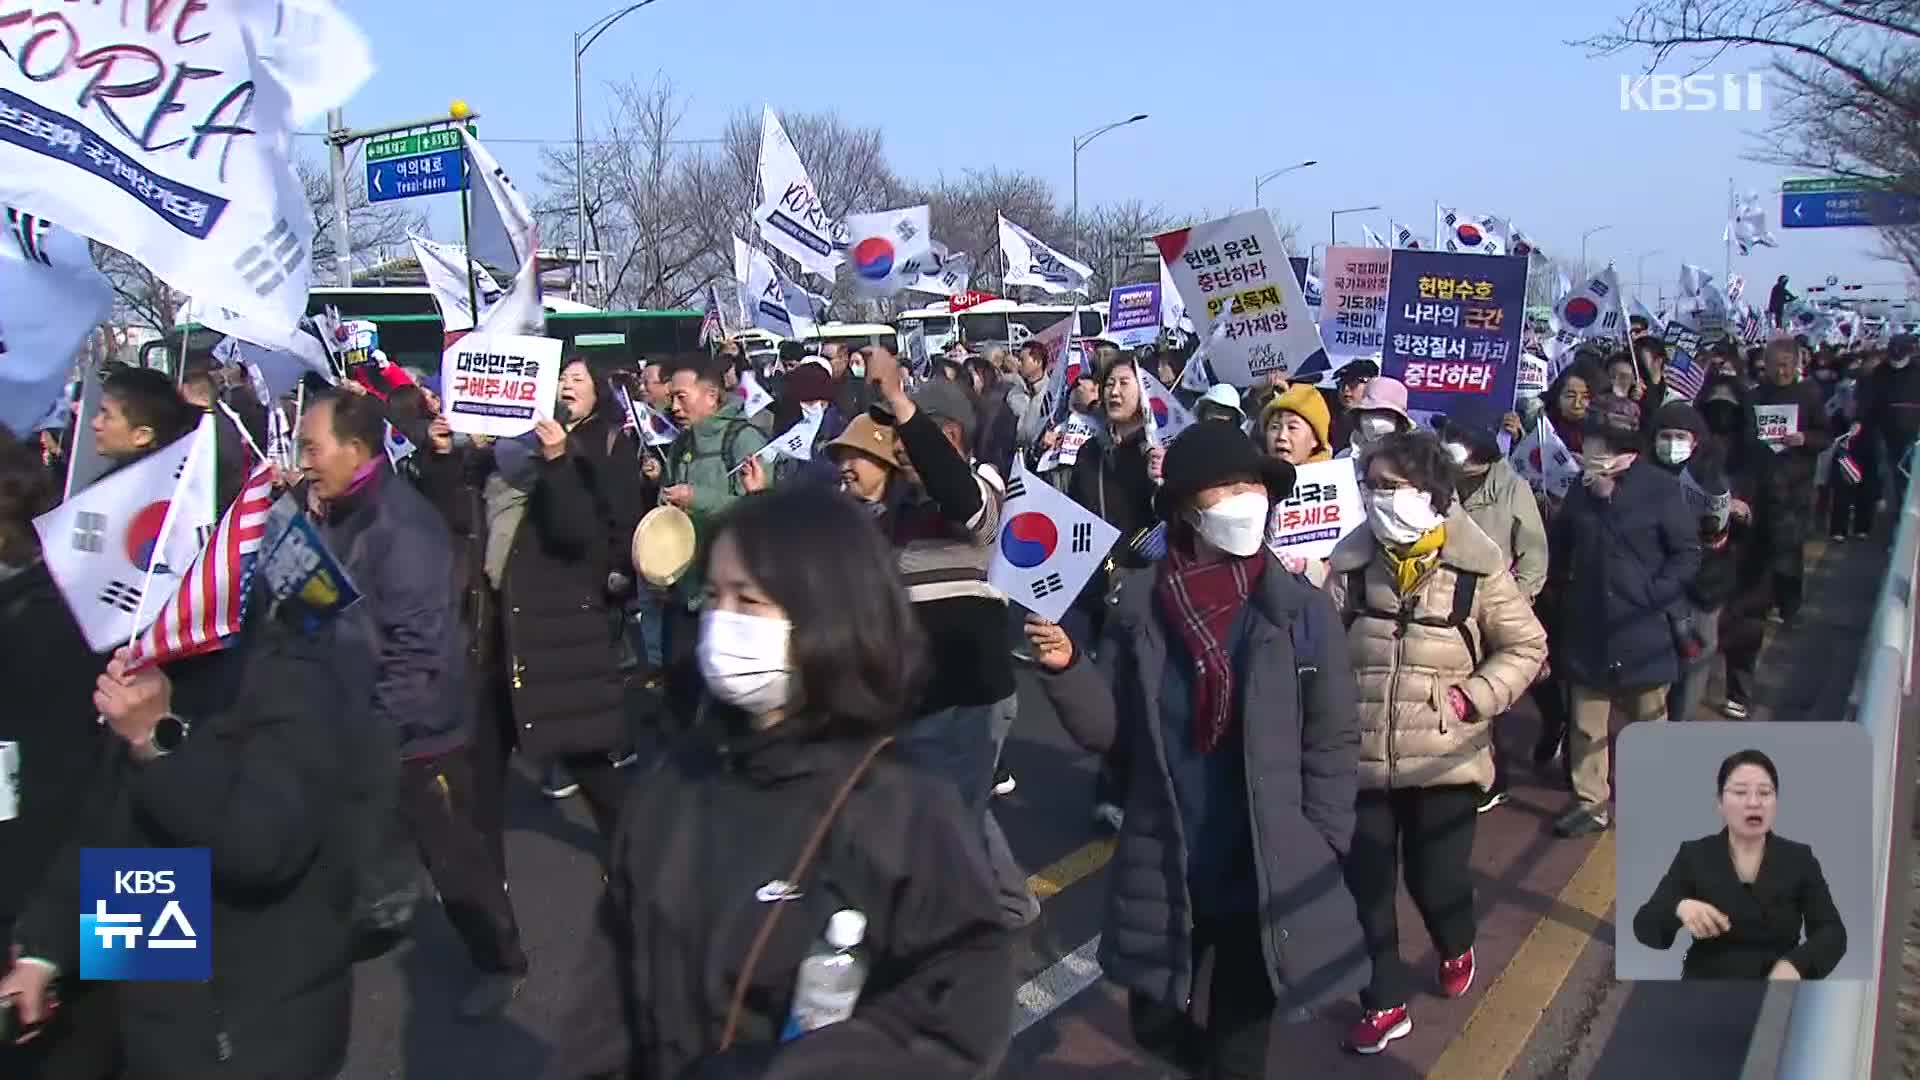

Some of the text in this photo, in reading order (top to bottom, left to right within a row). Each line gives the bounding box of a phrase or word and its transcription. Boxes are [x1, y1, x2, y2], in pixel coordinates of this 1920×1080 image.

[396, 156, 443, 178] 여의대로
[1183, 234, 1262, 271] 헌법 유린
[1198, 259, 1268, 293] 중단하라
[1418, 275, 1494, 301] 헌법수호
[1335, 311, 1377, 329] 국민이
[1404, 303, 1504, 331] 나라의 근간
[1392, 333, 1510, 365] 헌정질서 파괴
[456, 351, 540, 378] 대한민국을
[1404, 362, 1493, 391] 중단하라
[453, 376, 538, 401] 구해주세요
